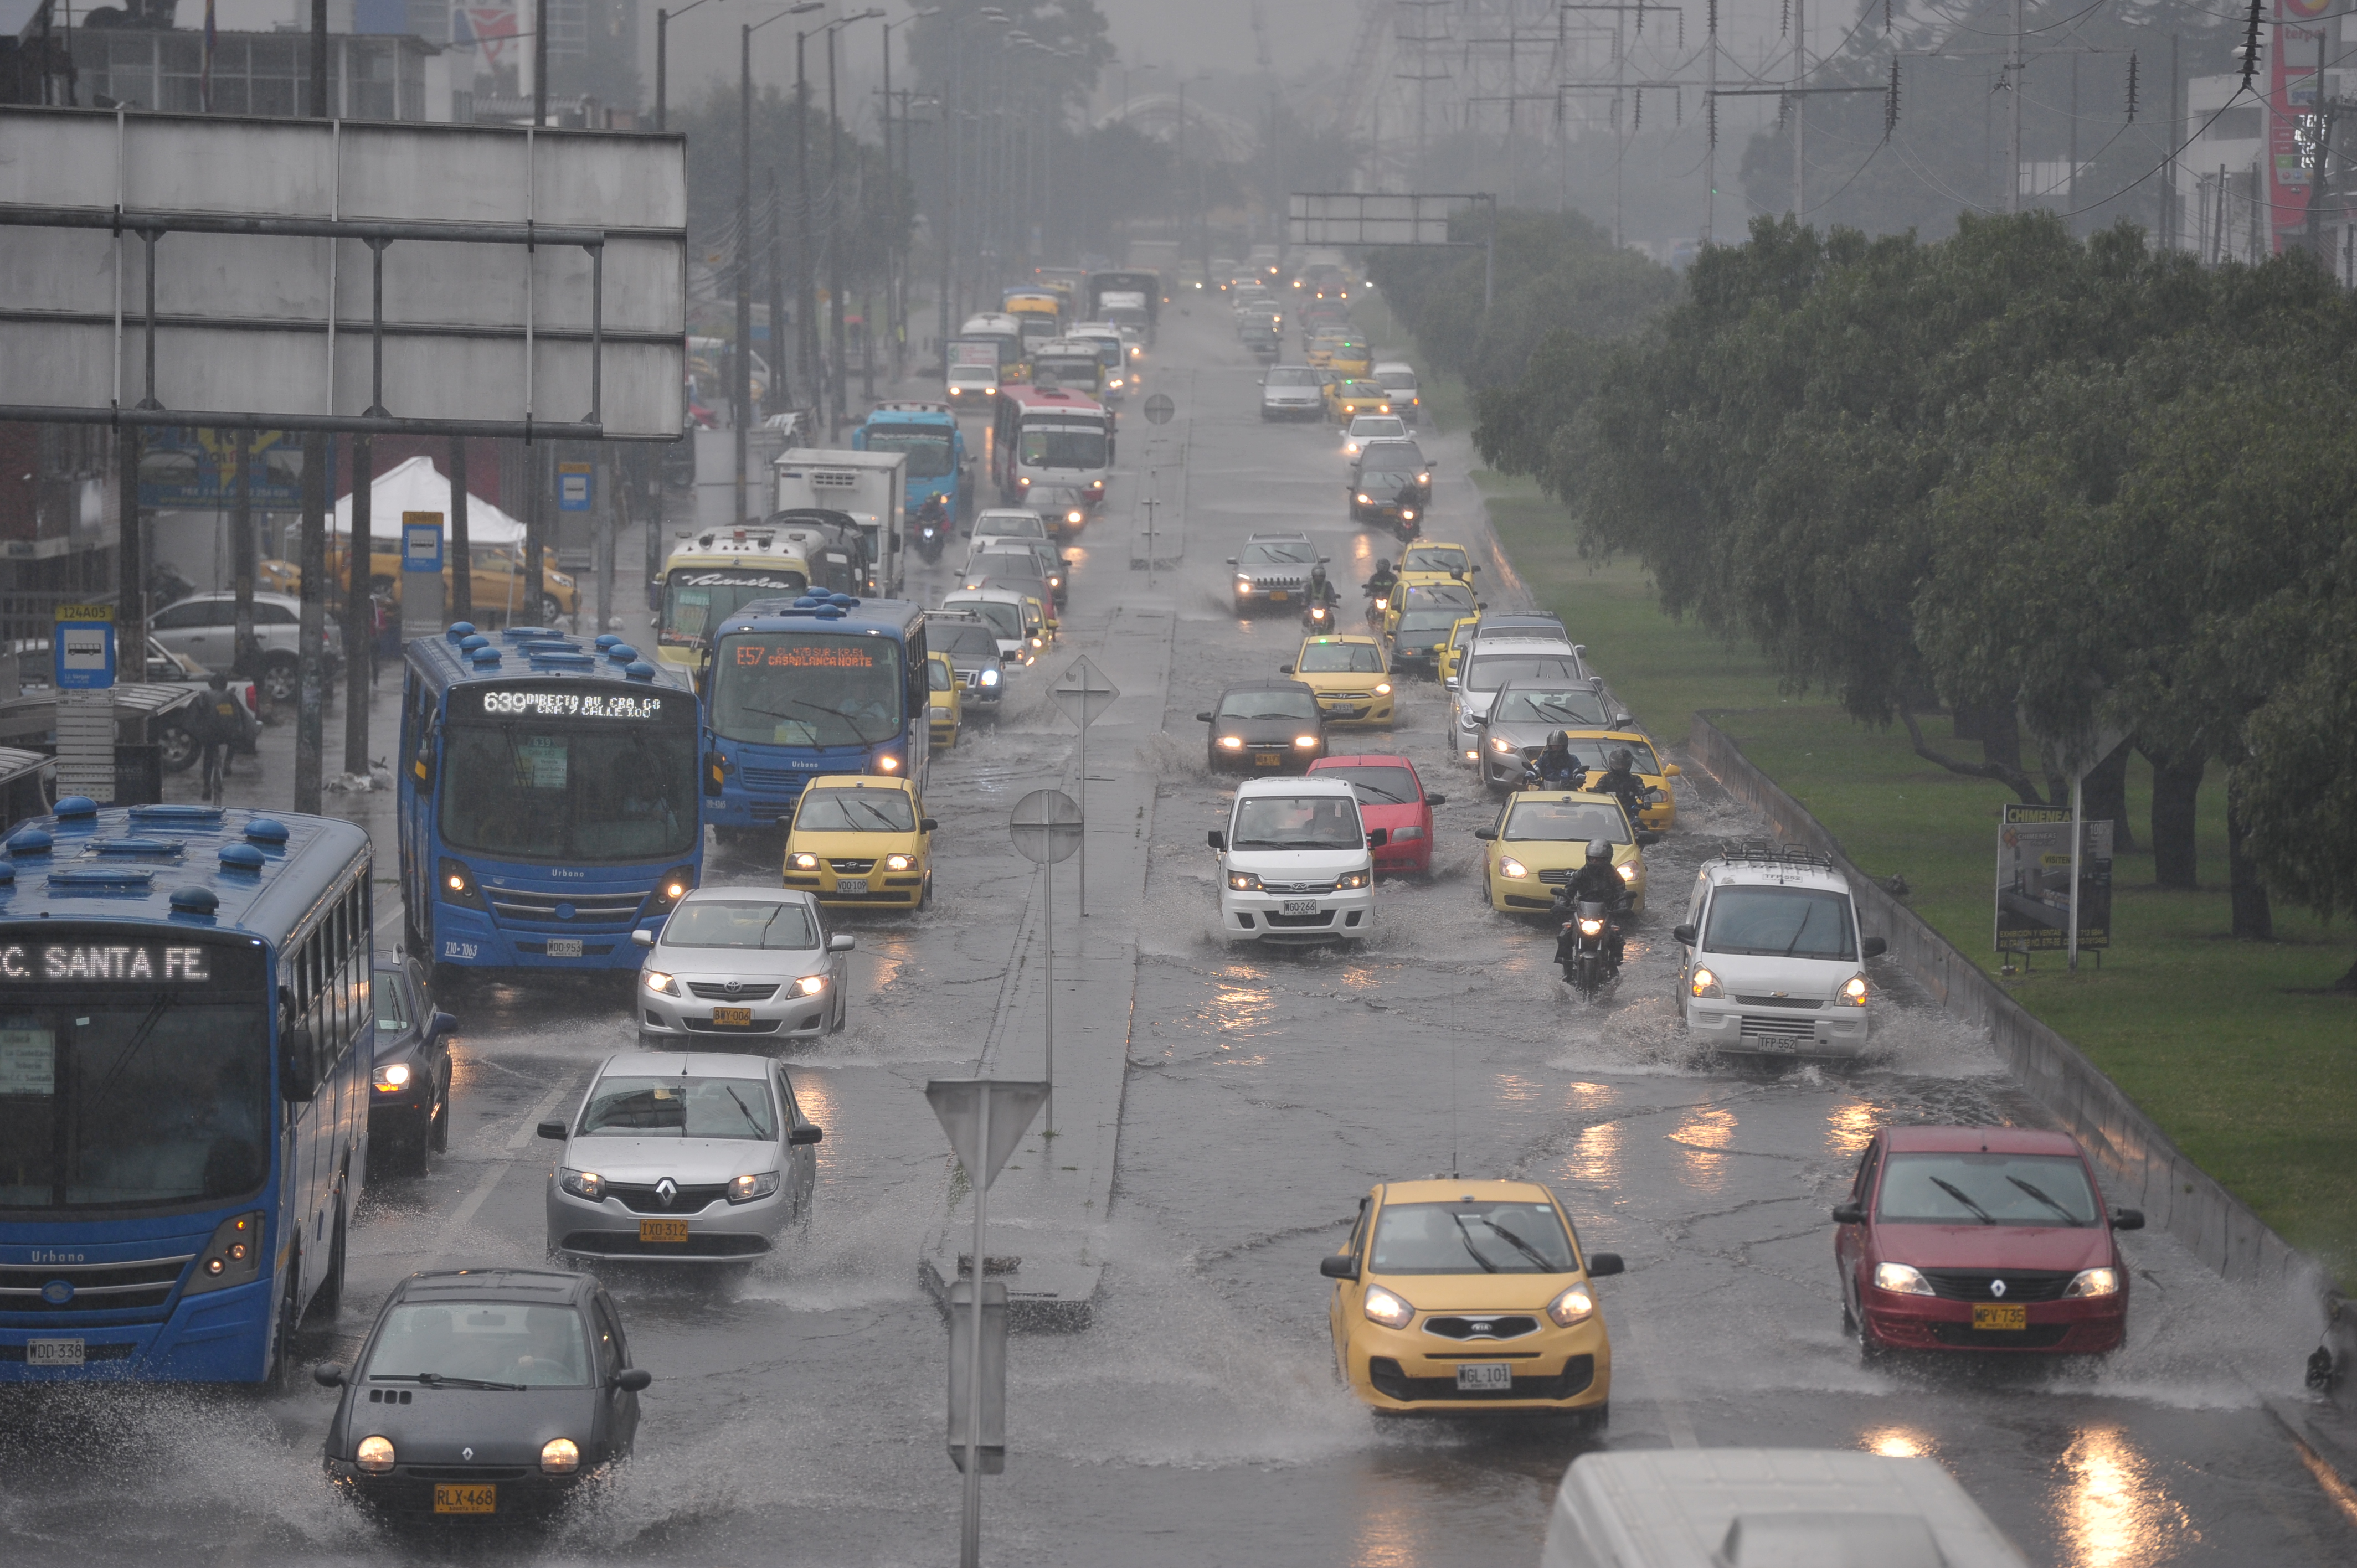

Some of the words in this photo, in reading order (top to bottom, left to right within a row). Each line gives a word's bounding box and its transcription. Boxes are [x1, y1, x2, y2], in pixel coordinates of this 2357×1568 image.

[64, 606, 106, 618] 124A05
[737, 647, 765, 666] E57
[814, 647, 831, 657] SUR
[838, 657, 872, 667] NORTE
[484, 691, 527, 713] 639
[527, 693, 579, 707] DIRECTO
[533, 738, 552, 747] 639
[2008, 808, 2073, 822] CHIMENEA
[552, 869, 585, 877] Urbano
[45, 946, 152, 978] SANTA
[166, 947, 208, 979] FE
[32, 1251, 85, 1262] Urbano
